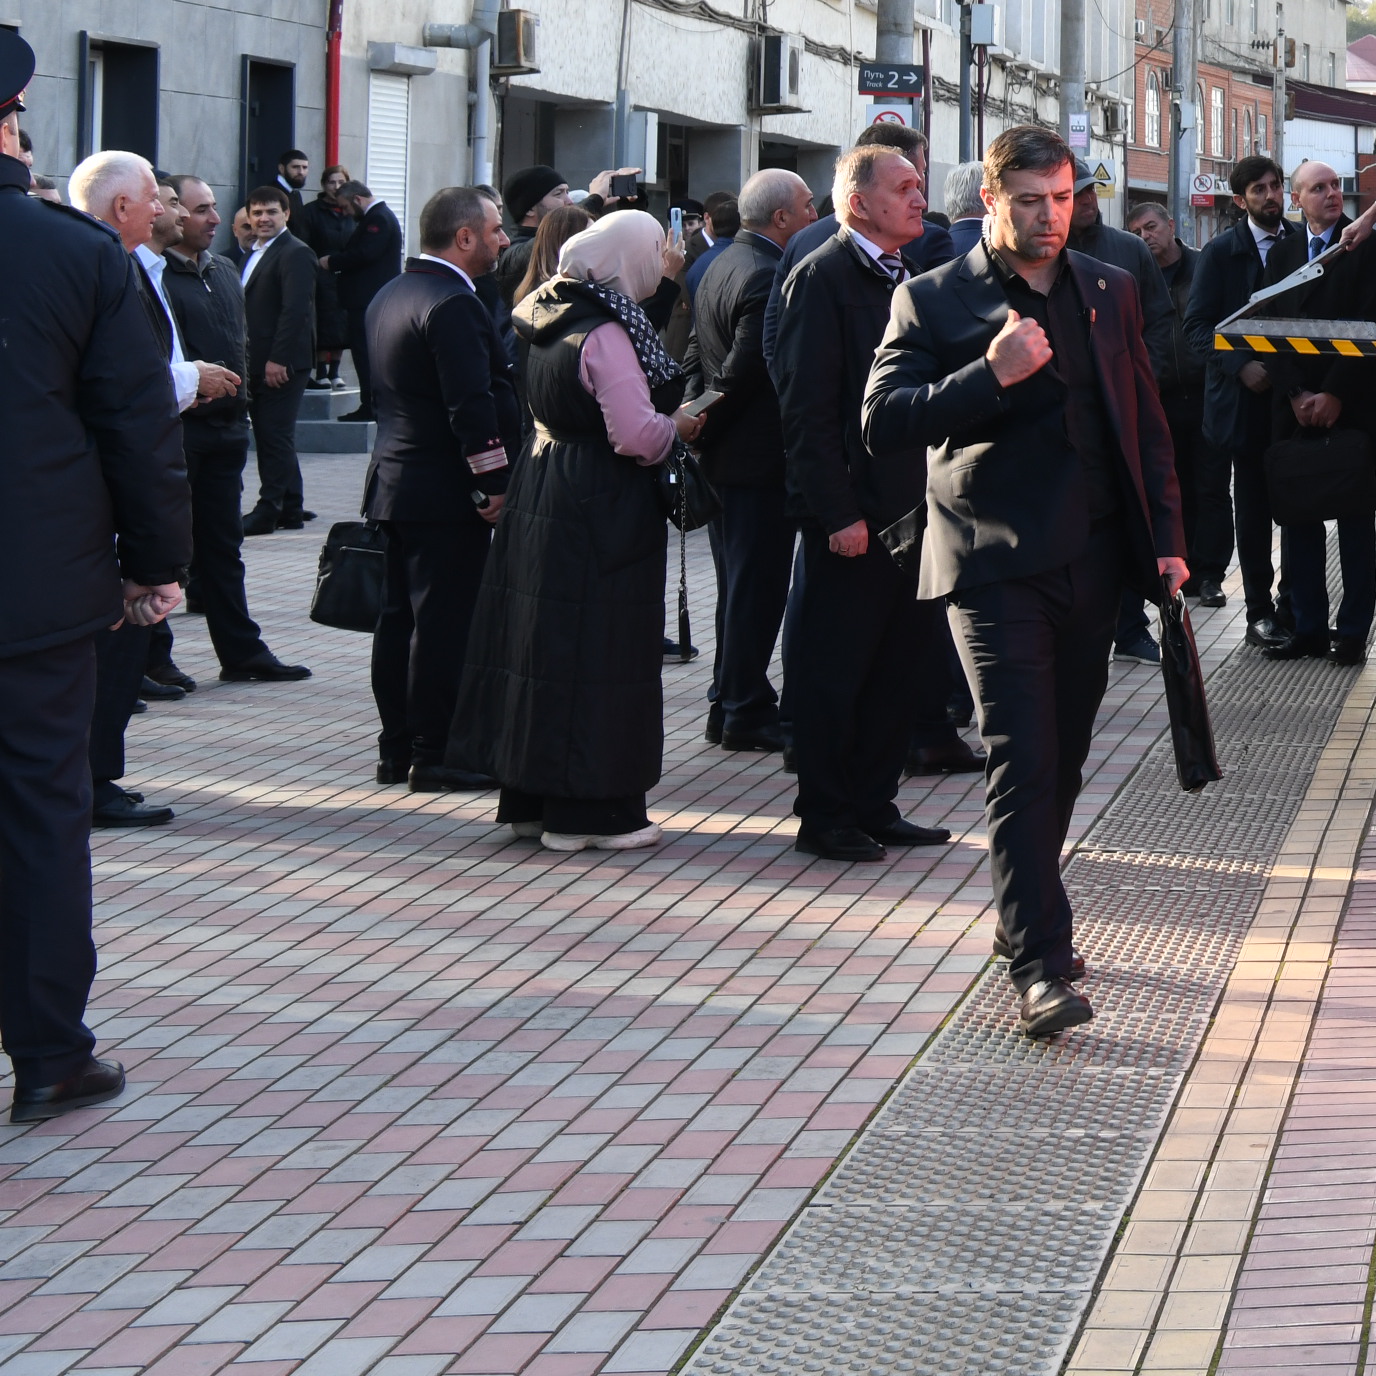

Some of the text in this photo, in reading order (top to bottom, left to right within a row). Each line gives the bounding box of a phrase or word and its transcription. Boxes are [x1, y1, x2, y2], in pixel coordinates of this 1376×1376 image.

[864, 69, 899, 88] Путь 2
[866, 80, 883, 88] Track
